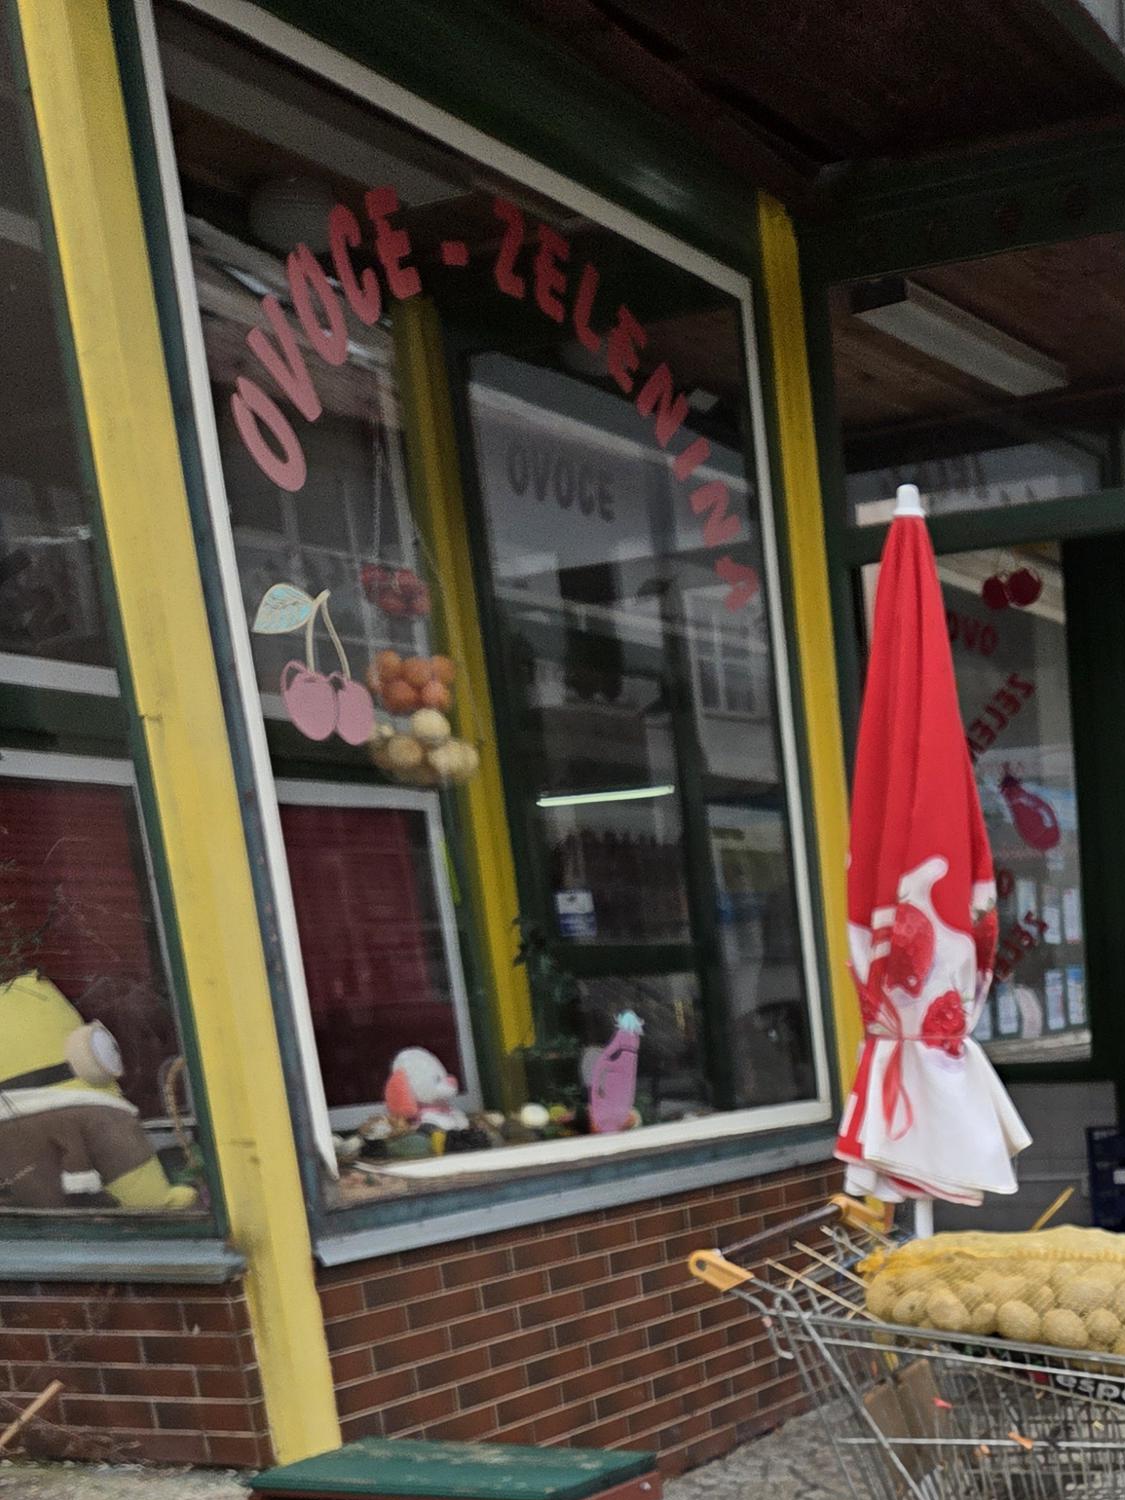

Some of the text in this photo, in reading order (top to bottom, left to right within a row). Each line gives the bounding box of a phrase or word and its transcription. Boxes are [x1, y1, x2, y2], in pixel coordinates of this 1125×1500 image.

[230, 185, 423, 492] OVOCE
[493, 196, 761, 614] ZELENINA
[507, 446, 616, 523] OVOCE
